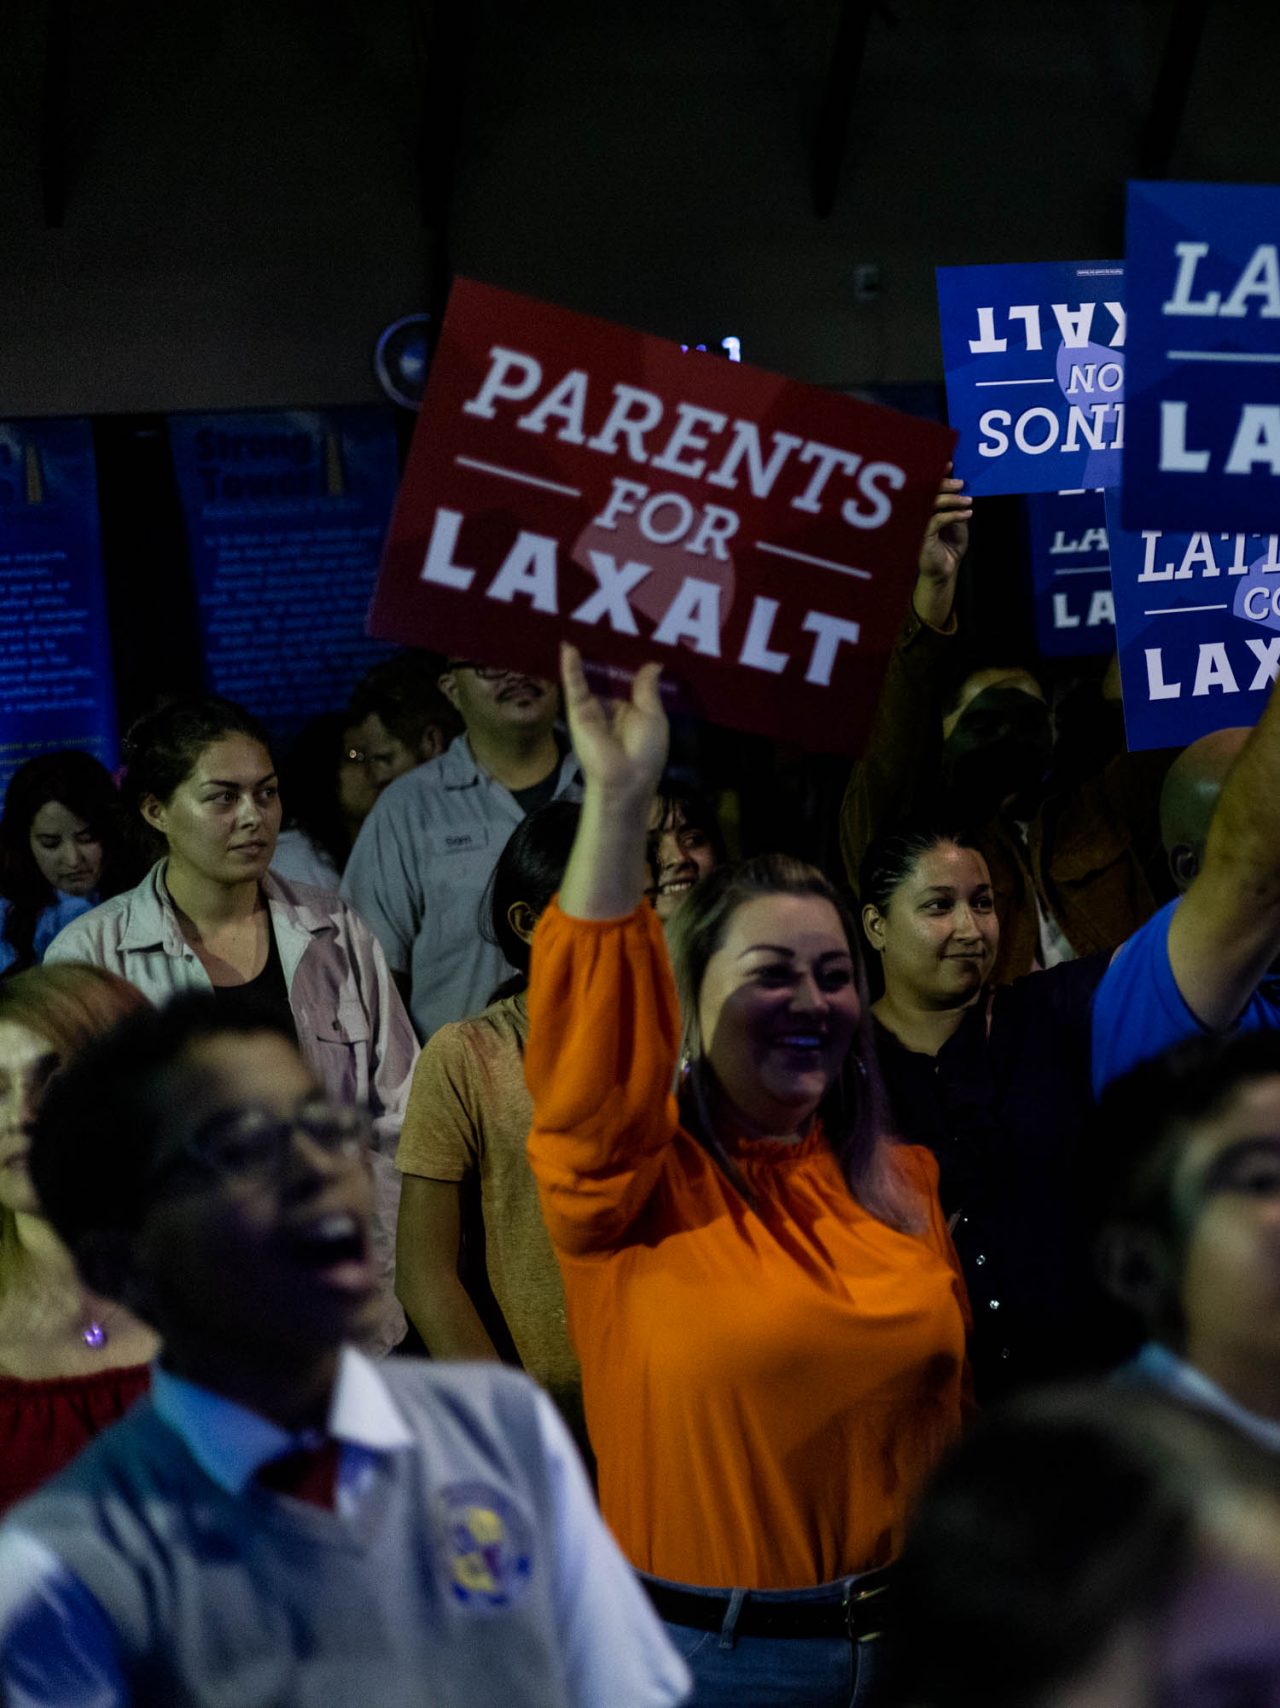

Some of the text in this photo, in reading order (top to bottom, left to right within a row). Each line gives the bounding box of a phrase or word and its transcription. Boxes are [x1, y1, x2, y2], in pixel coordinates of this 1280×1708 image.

[968, 302, 1127, 354] XALT
[1066, 362, 1125, 395] ON
[461, 344, 908, 531] PARENTS
[977, 402, 1126, 458] INOS
[594, 476, 741, 562] FOR
[419, 506, 862, 687] LAXALT
